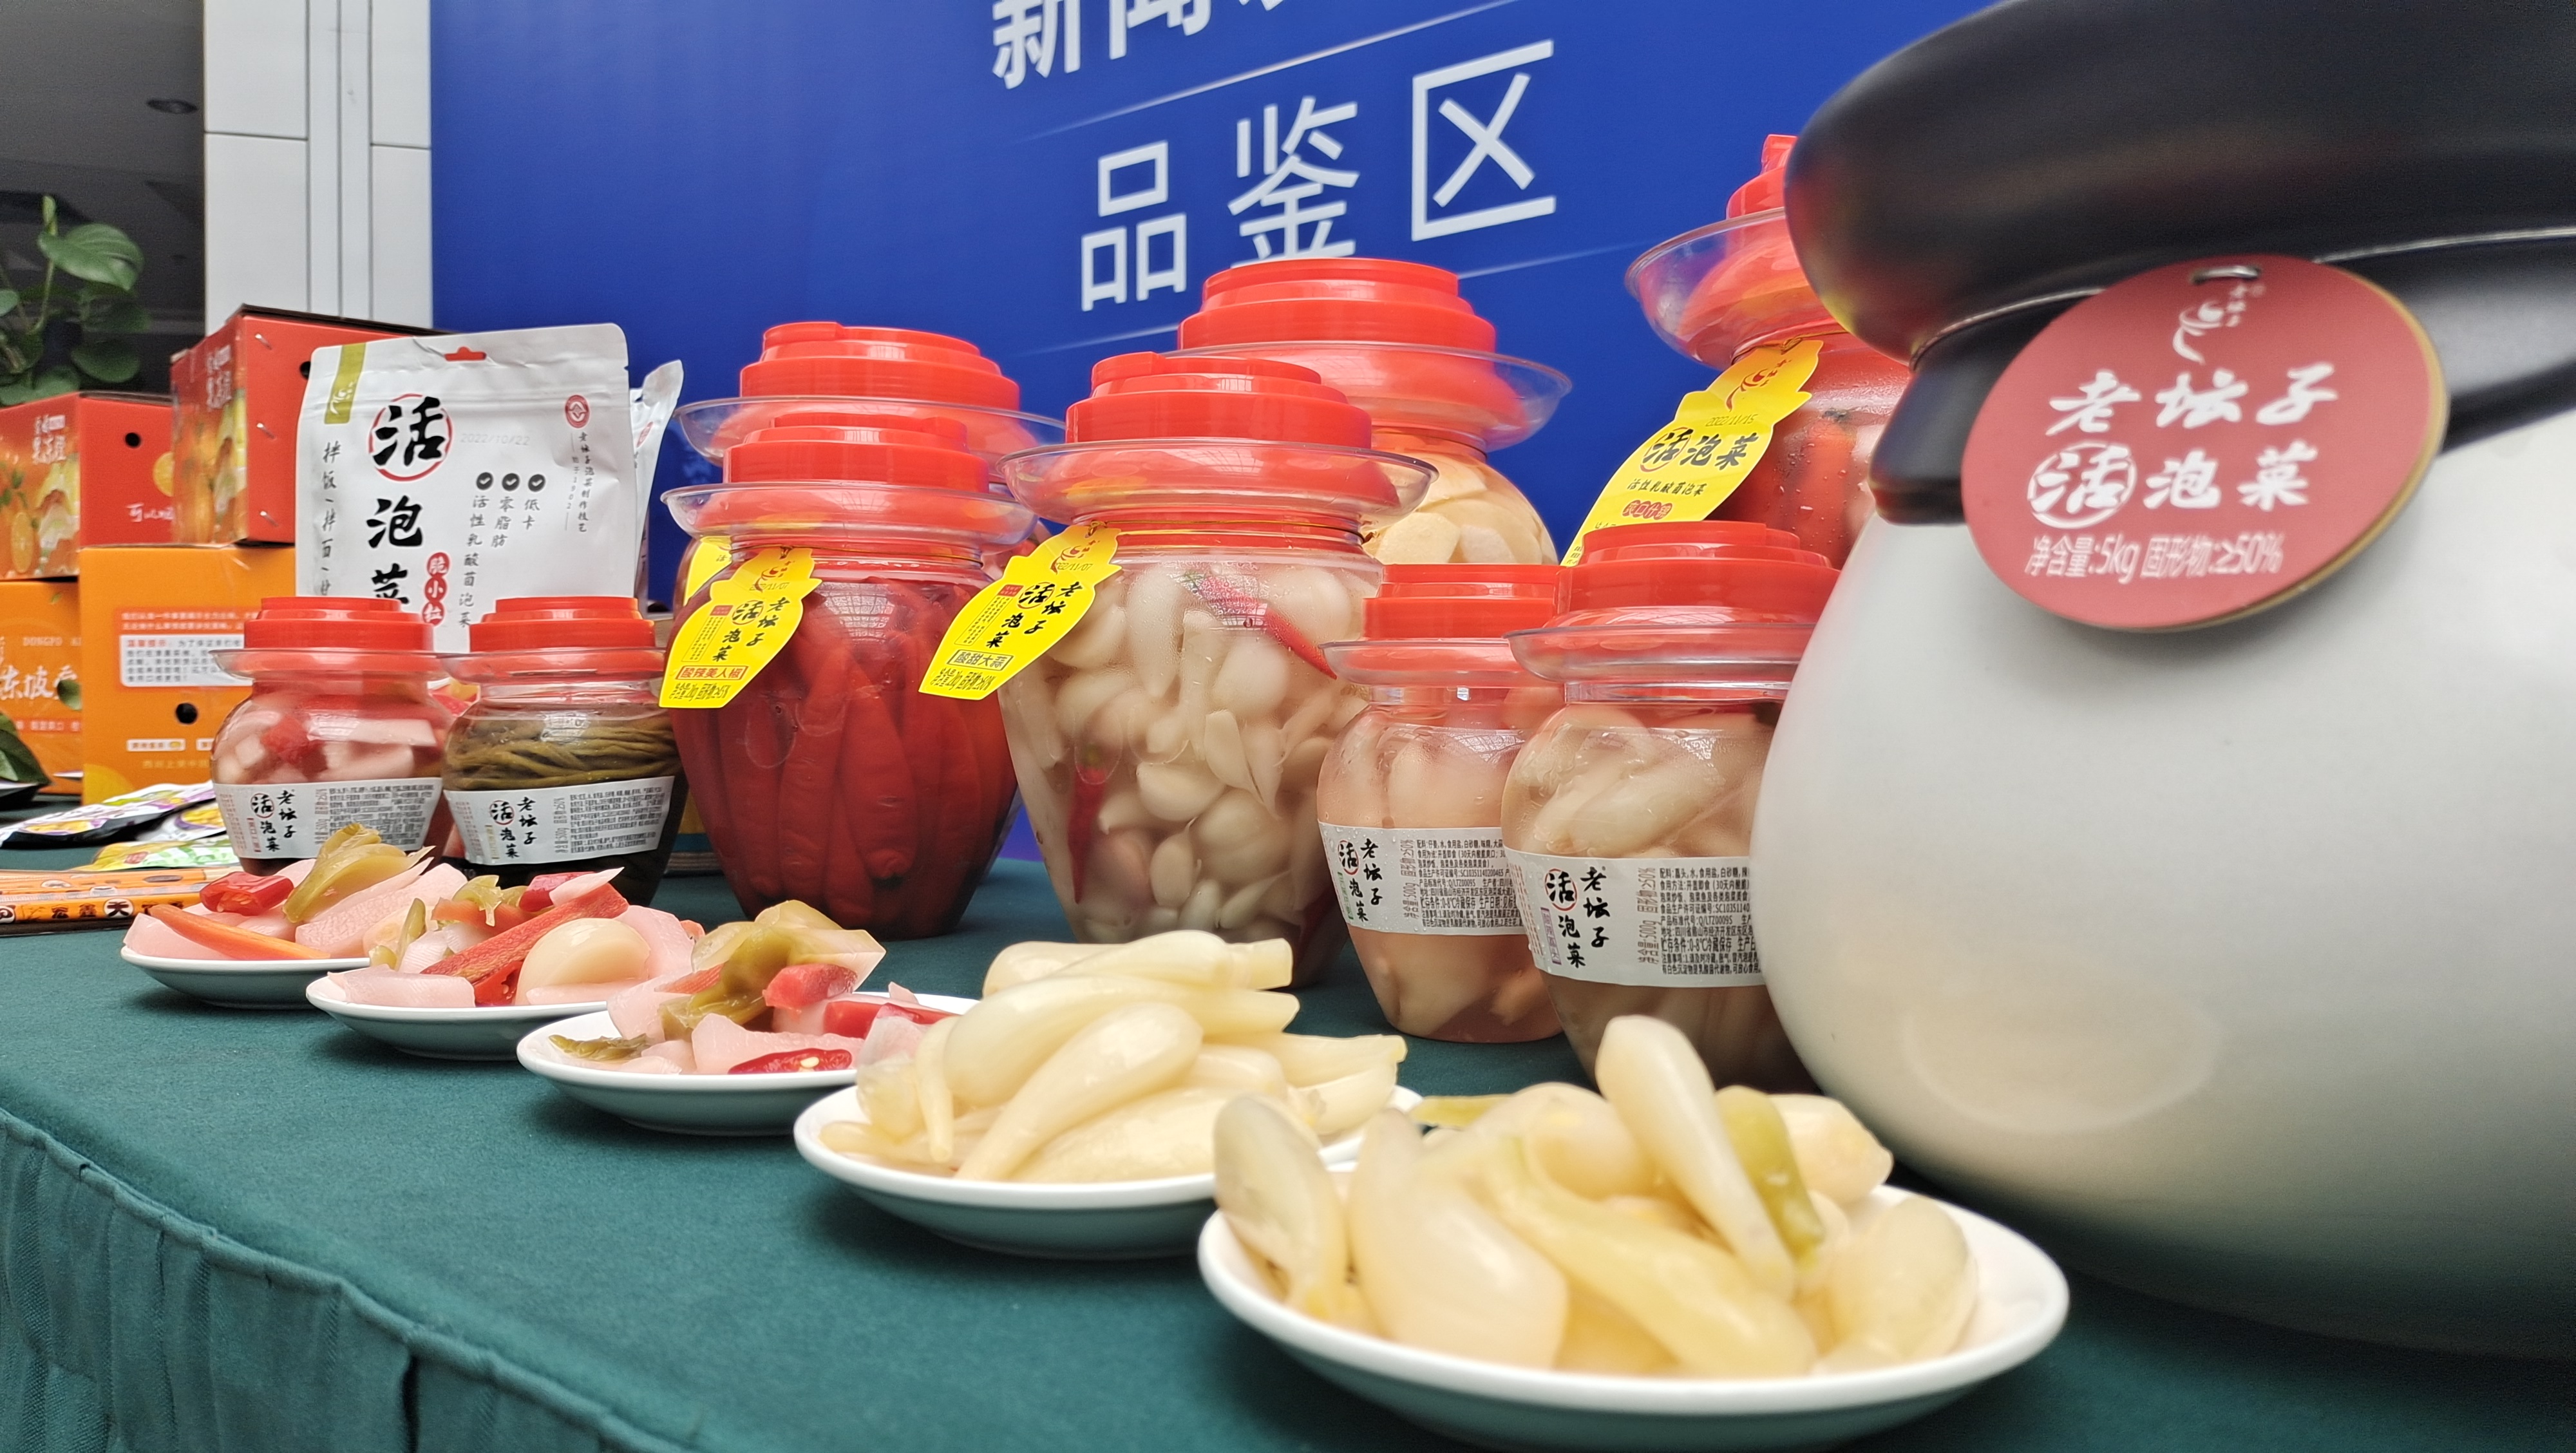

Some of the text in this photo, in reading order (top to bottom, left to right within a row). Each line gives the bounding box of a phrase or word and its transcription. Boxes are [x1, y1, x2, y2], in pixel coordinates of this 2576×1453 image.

[1082, 39, 1556, 312] 品鉴区
[1705, 413, 1758, 426] 2022/11/15
[2044, 362, 2338, 436] 老坛子
[1641, 428, 1759, 471] 活泡菜
[1627, 478, 1707, 497] 活性乳酸菌泡菜
[2027, 441, 2319, 524] 活泡菜
[491, 496, 515, 547] 零脂肪
[523, 498, 540, 530] 低卡
[459, 495, 490, 628] 活性乳酸菌泡菜
[2024, 532, 2285, 585] 净含量:5kg 固形物:≥50%
[712, 600, 764, 662] 活泡菜
[746, 596, 790, 647] 老坛子
[986, 584, 1056, 649] 活泡菜
[1024, 581, 1084, 634] 老坛子
[954, 651, 1007, 669] 酸甜大蒜
[251, 793, 280, 852] 活泡菜
[277, 788, 298, 839] 老坛子
[491, 801, 520, 859] 活泡菜
[517, 797, 538, 845] 老坛子
[1338, 841, 1369, 922] 活泡菜
[1360, 838, 1383, 906] 老坛子
[1546, 871, 1586, 969] 活泡菜
[1580, 866, 1611, 948] 老坛子
